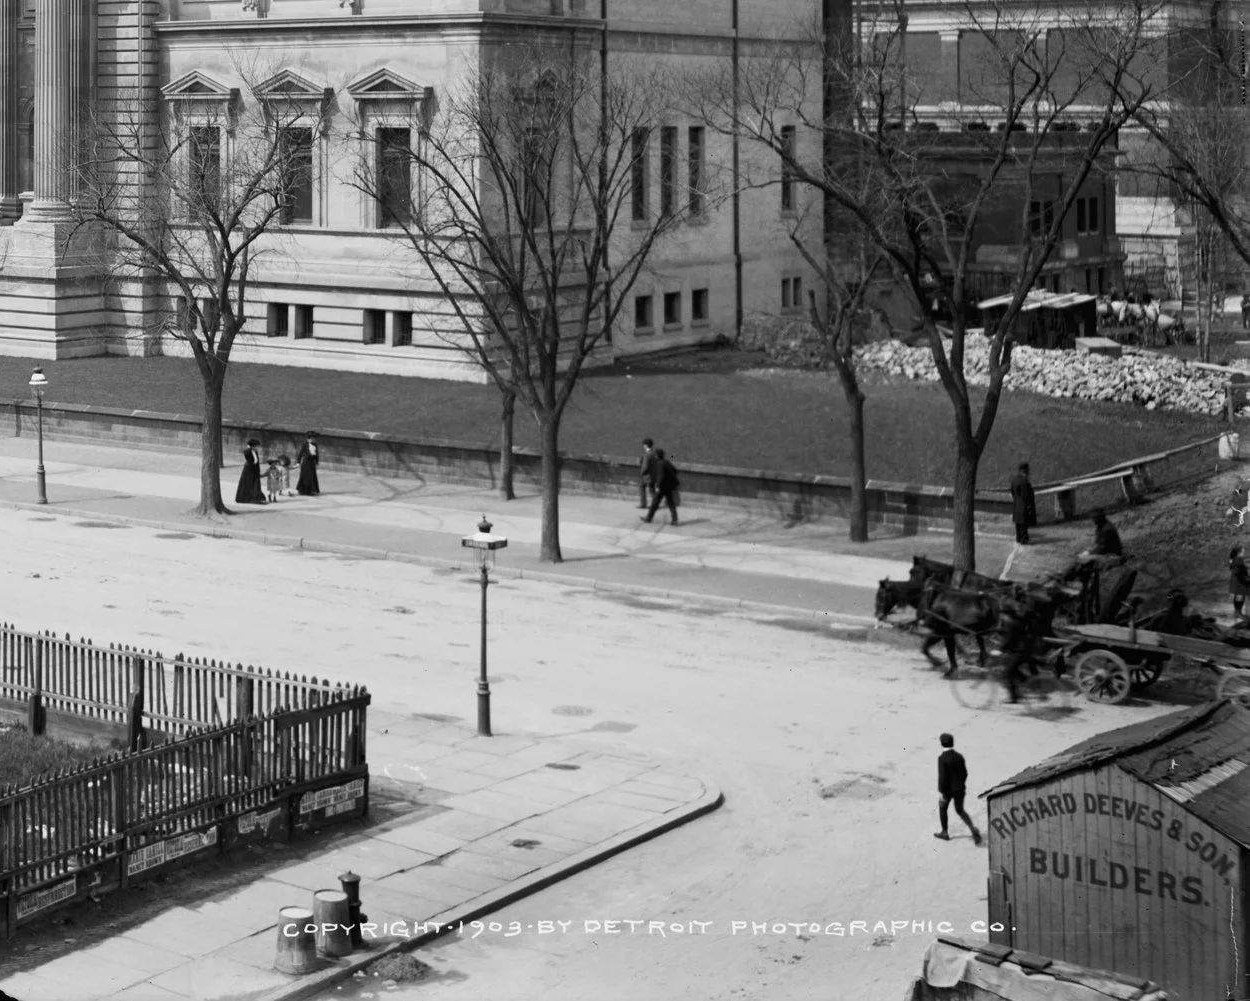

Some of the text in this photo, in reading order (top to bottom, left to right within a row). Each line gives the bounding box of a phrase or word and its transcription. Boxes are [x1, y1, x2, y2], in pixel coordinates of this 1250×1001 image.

[991, 792, 1078, 840] RICHARD
[1083, 792, 1166, 832] DEEVES
[1166, 819, 1183, 842] &
[1029, 846, 1210, 908] BUILDERS.
